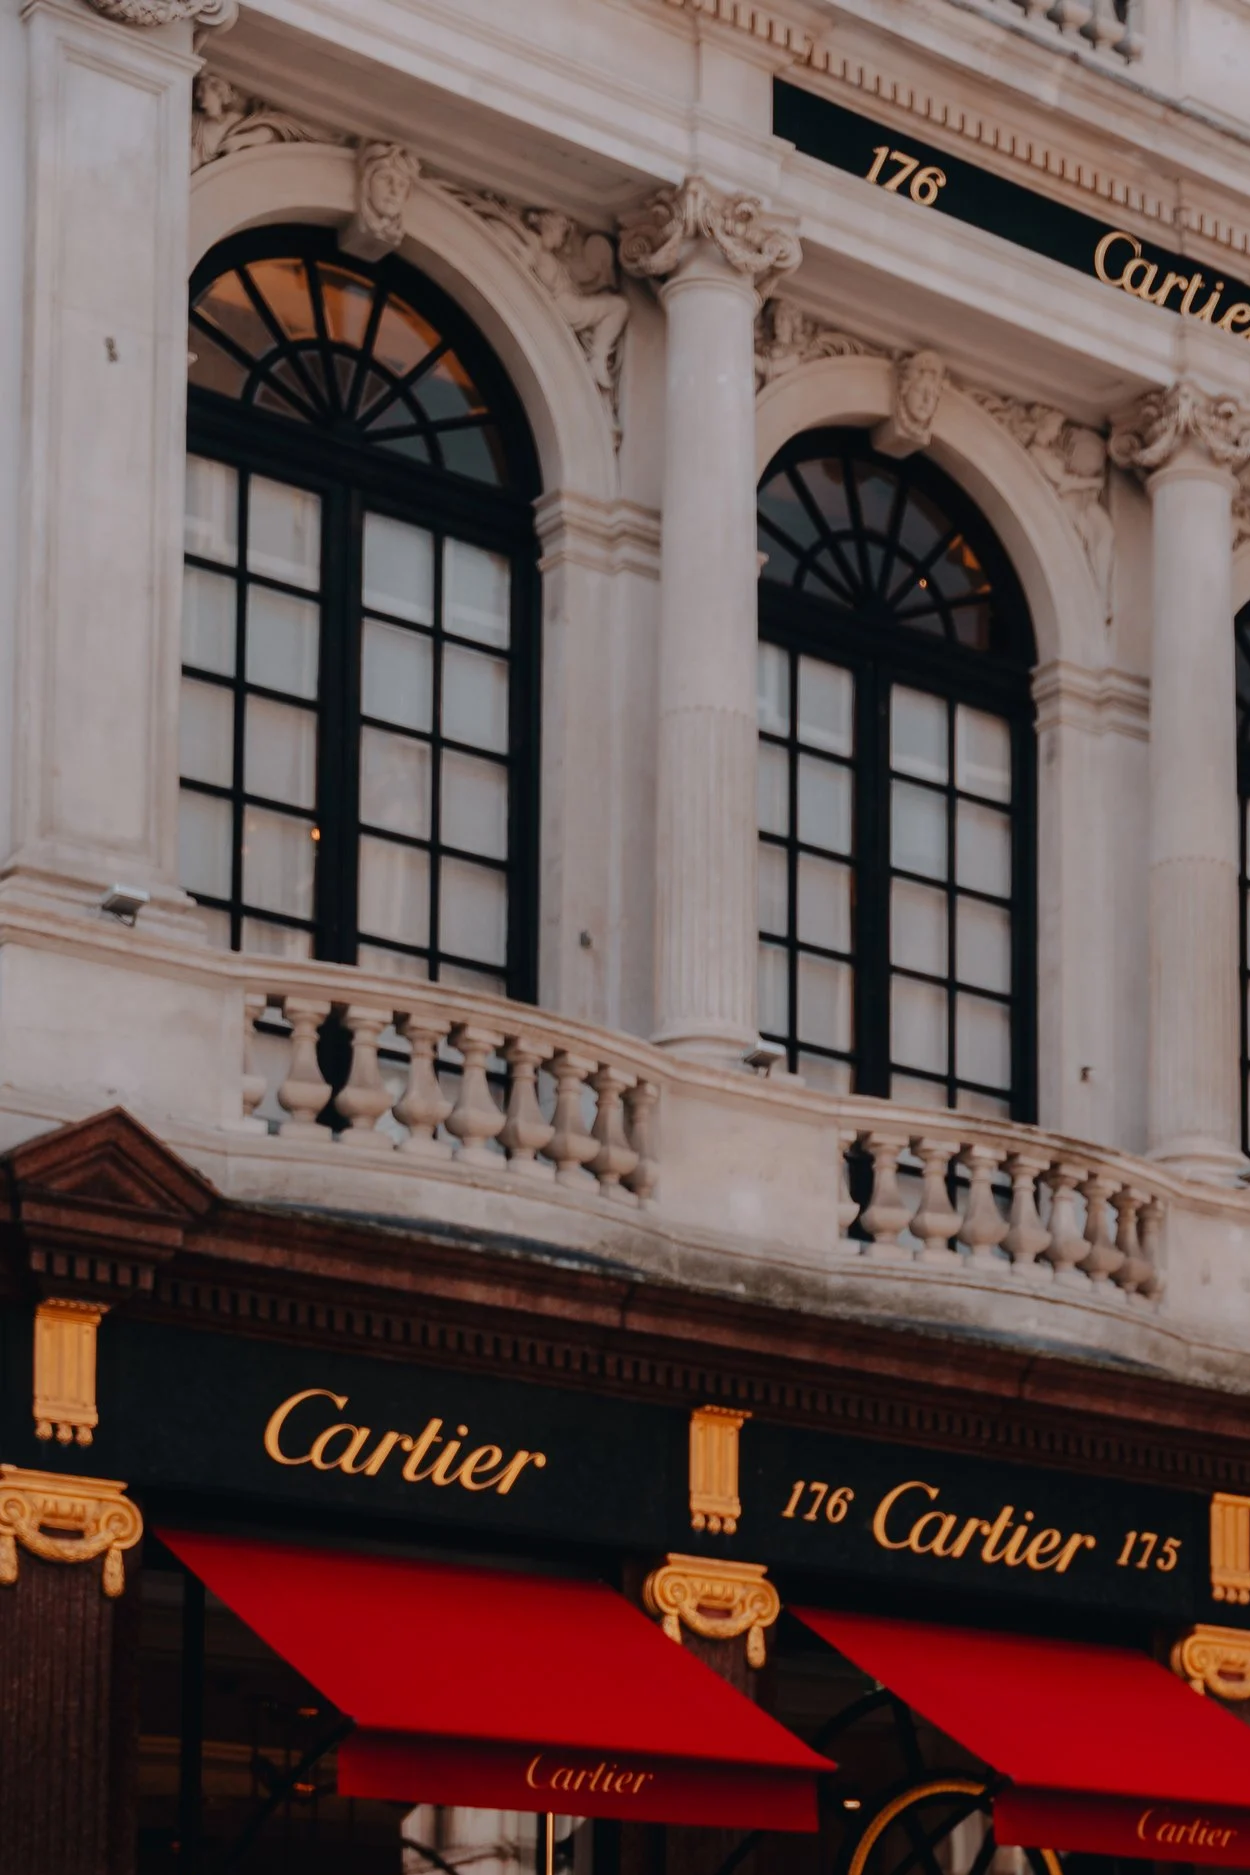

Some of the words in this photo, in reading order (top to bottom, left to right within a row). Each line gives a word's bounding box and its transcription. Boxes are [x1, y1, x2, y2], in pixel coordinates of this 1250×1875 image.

[864, 146, 947, 206] 176
[263, 1388, 547, 1495] Cartier
[781, 1481, 854, 1524] 176
[872, 1480, 1096, 1573] Cartier
[1116, 1531, 1183, 1572] 175
[526, 1754, 654, 1794] Cartier
[1137, 1808, 1239, 1848] Cartier
